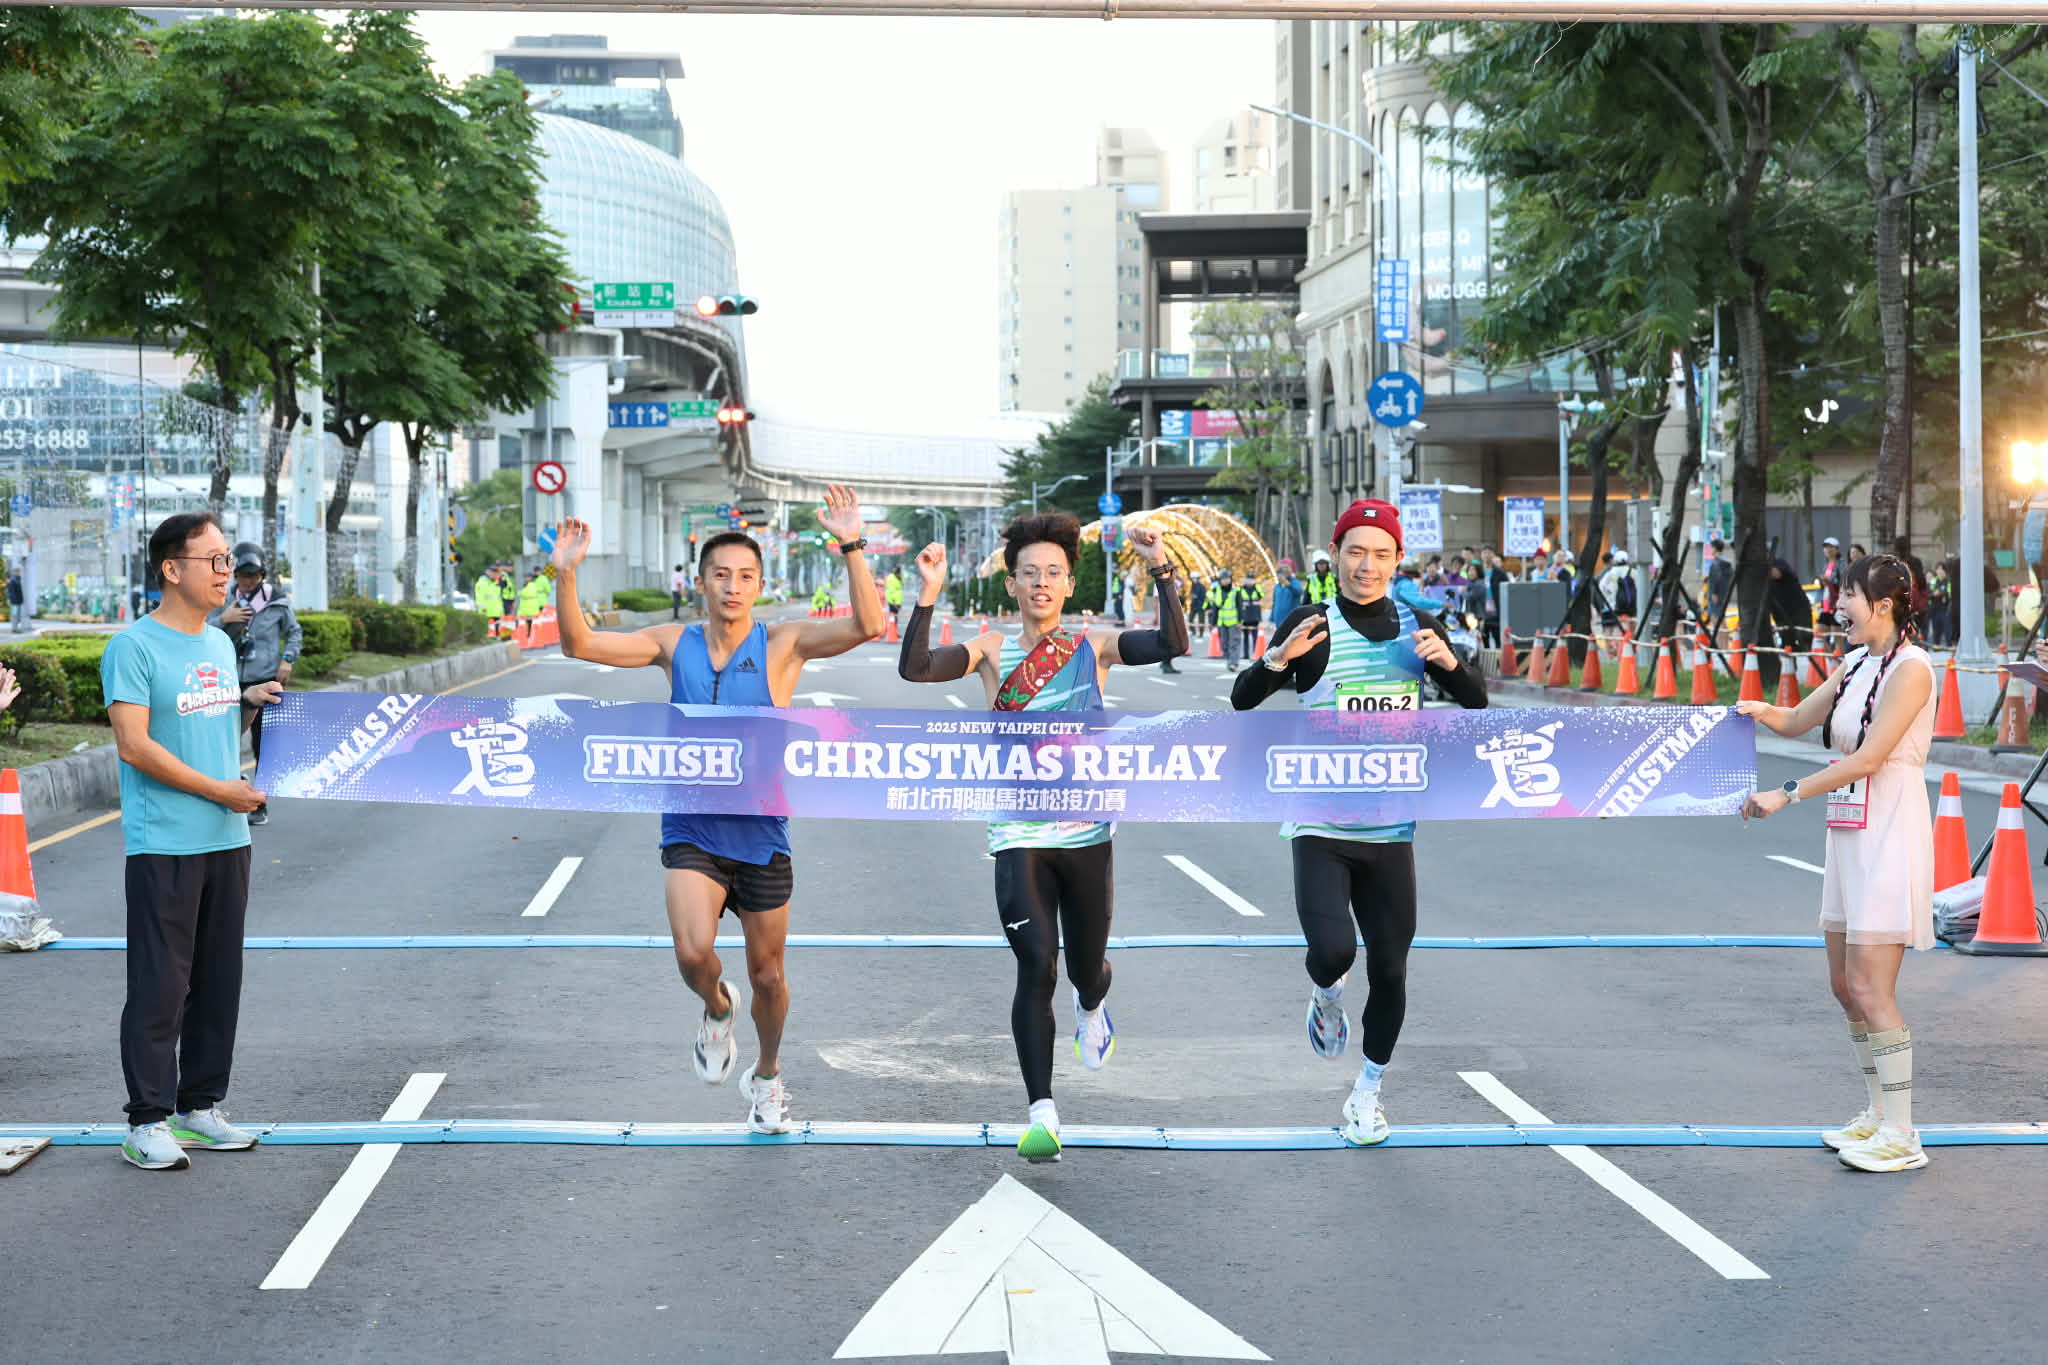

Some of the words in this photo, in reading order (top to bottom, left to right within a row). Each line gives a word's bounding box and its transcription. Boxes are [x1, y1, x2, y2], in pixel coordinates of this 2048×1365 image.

[1347, 695, 1412, 711] 006-2
[926, 721, 957, 734] 2025
[959, 721, 996, 734] NEW
[998, 721, 1047, 735] TAIPEI
[1049, 722, 1085, 735] CITY
[590, 743, 737, 778] FINISH
[783, 740, 1063, 781] CHRISTMAS
[1071, 744, 1227, 782] RELAY
[1272, 753, 1421, 785] FINISH
[886, 786, 1128, 812] 新北市耶誕馬拉松接力賽
